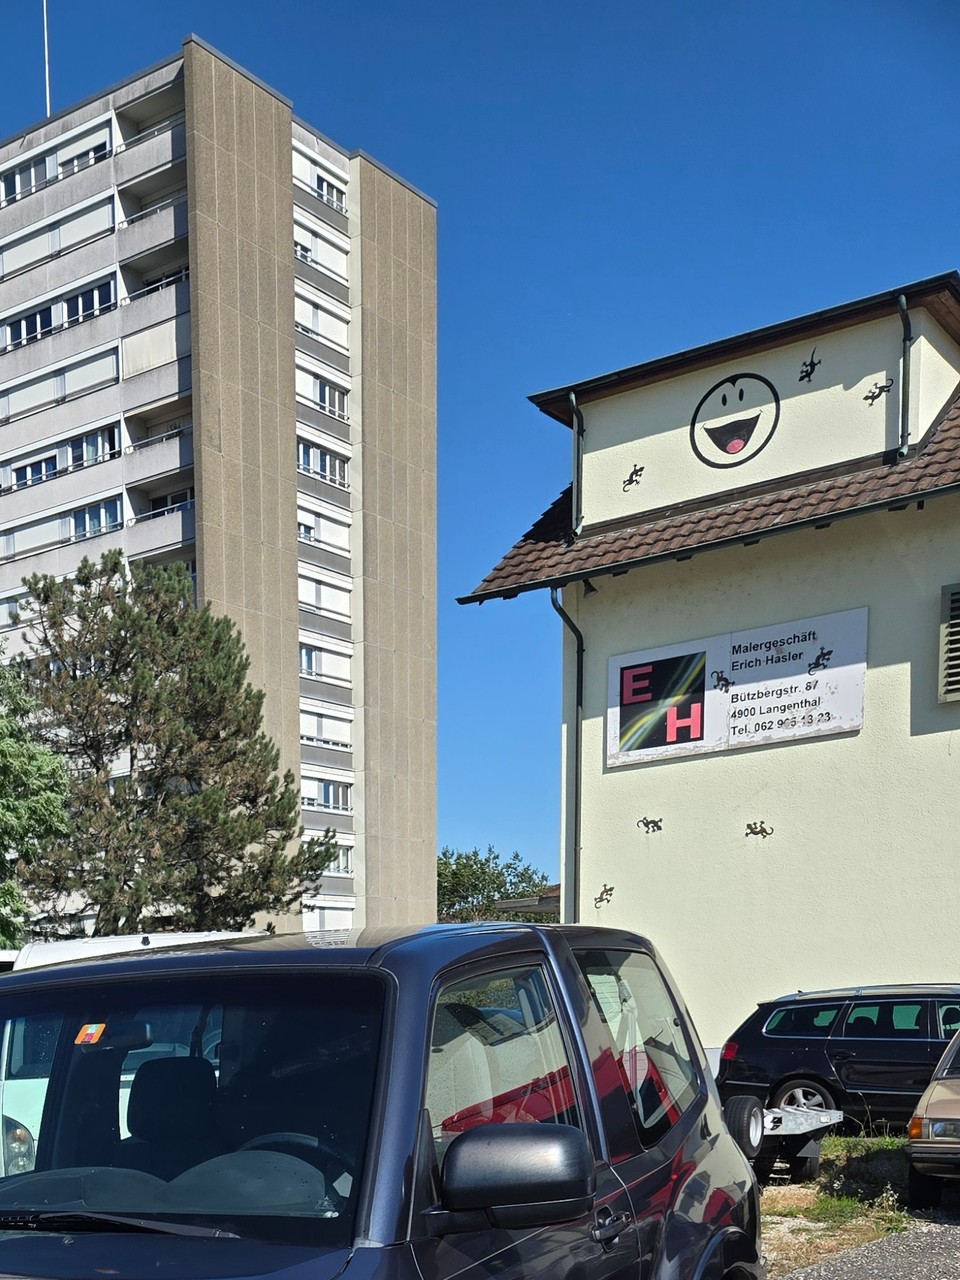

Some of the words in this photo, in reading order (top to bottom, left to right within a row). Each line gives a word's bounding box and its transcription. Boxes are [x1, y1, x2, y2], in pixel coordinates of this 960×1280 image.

[731, 630, 817, 655] Malergeschäft
[731, 657, 762, 671] Erich
[765, 651, 804, 665] Hasler
[623, 665, 653, 705] E
[731, 684, 802, 704] Bützbergstr.
[731, 706, 756, 719] 4900
[759, 696, 821, 714] Langenthal
[666, 702, 702, 742] H
[731, 724, 751, 736] Tel.
[754, 720, 774, 732] 062
